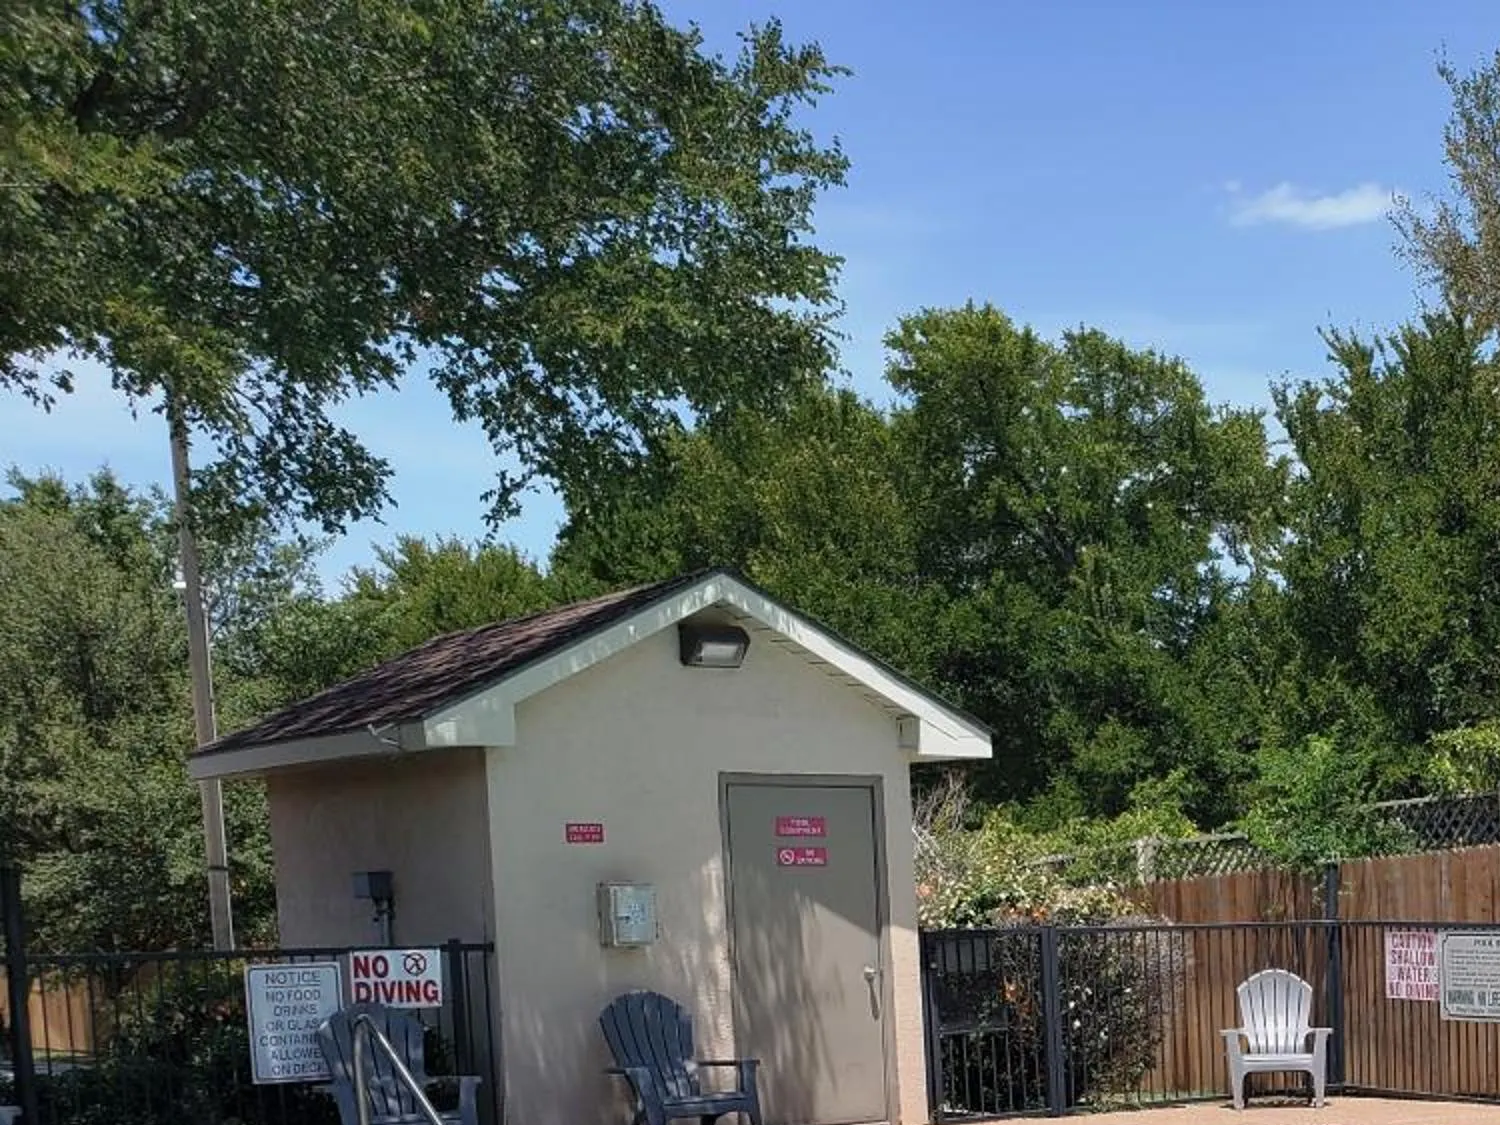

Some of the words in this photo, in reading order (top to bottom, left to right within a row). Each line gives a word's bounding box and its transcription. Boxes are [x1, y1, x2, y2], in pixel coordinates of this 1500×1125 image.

[1391, 934, 1434, 949] CAUTION
[1391, 950, 1435, 966] SHALLOW
[353, 955, 389, 979] NO
[1397, 967, 1433, 982] WATER
[265, 971, 321, 985] NOTICE
[265, 991, 284, 1002] NO
[287, 989, 321, 1001] FOOD
[354, 980, 439, 1004] DIVING
[273, 1003, 318, 1017] DRINKS
[271, 1048, 321, 1061] ALLOWE
